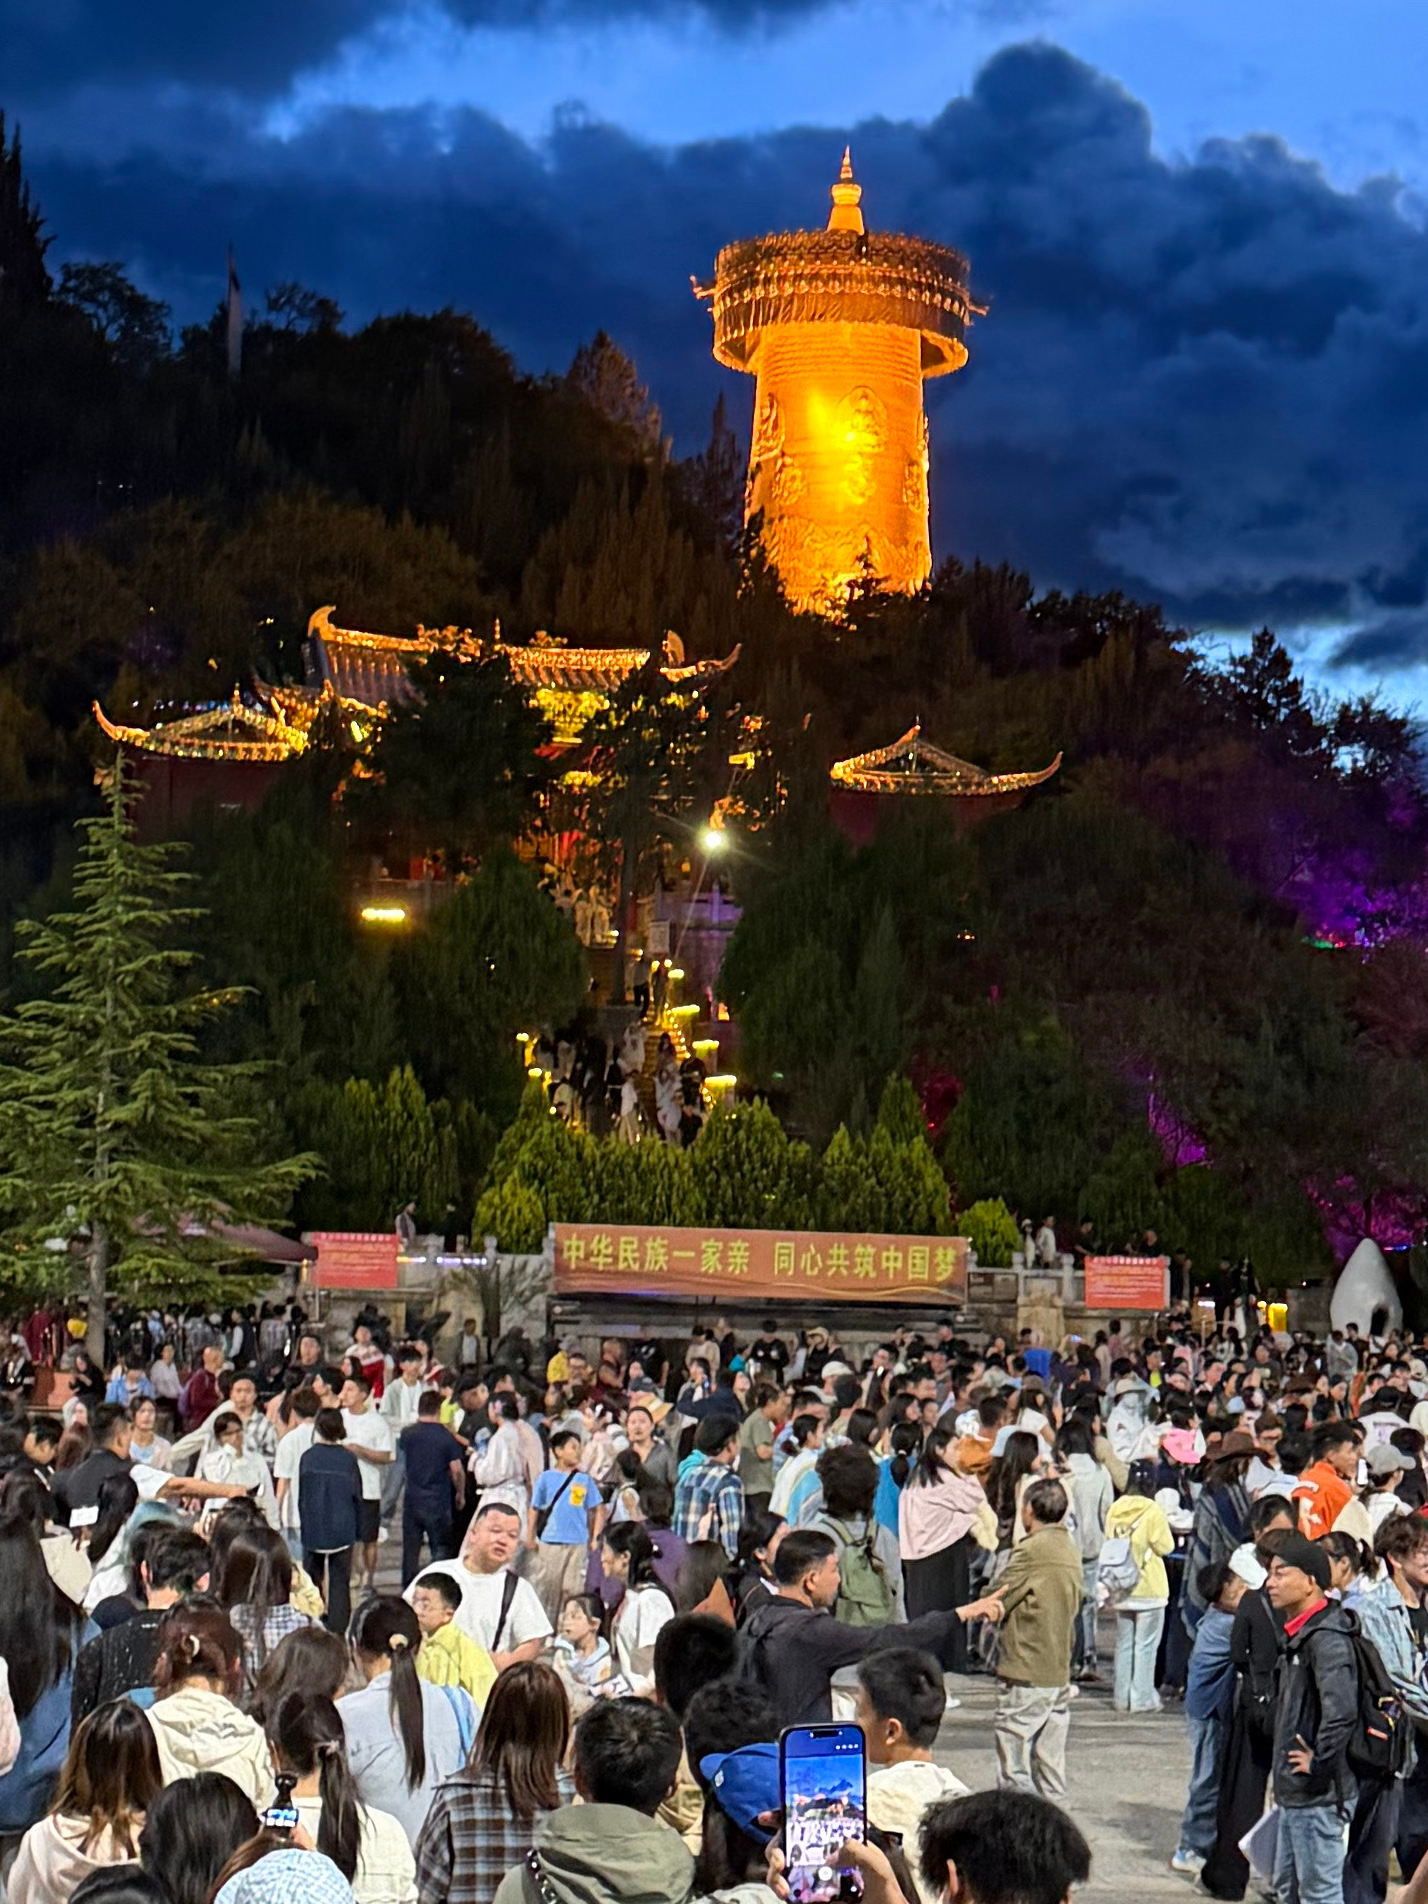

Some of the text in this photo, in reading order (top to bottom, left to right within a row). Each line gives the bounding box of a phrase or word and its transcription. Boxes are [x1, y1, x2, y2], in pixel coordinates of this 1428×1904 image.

[562, 1232, 957, 1282] 中华民族一家亲 同心共筑中国梦
